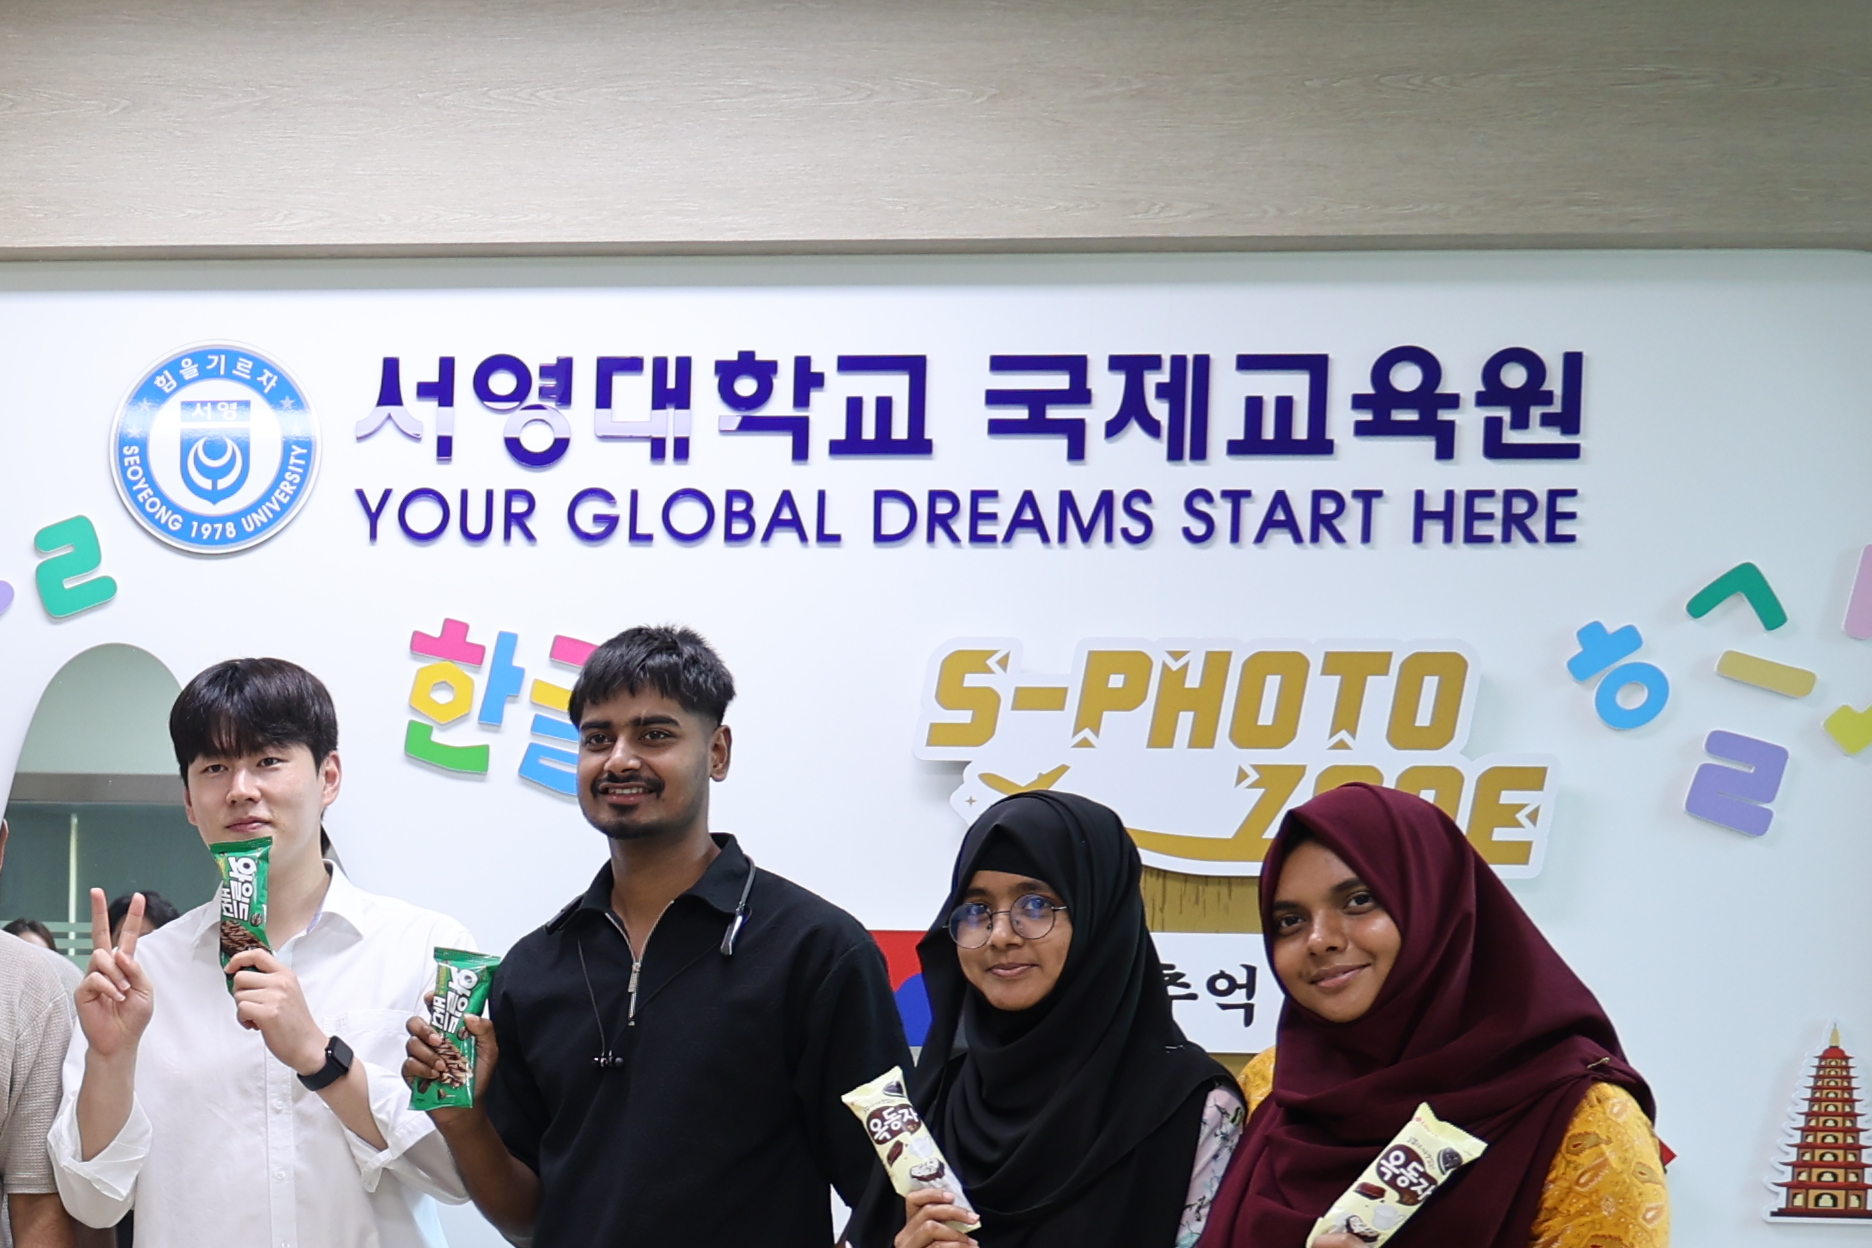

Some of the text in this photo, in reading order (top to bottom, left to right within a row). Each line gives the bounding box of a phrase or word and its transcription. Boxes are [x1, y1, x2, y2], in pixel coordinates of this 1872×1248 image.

[191, 401, 238, 420] 서영
[354, 345, 1585, 468] 서영대학교 국제교육원
[123, 444, 308, 540] SEOYEONG 1978 UNIVERSITY
[354, 487, 1580, 546] YOUR GLOBAL DREAMS START HERE
[925, 649, 1470, 751] S-PHOTO
[869, 1107, 919, 1141] 옥동자
[1380, 1149, 1436, 1200] 옥동자
